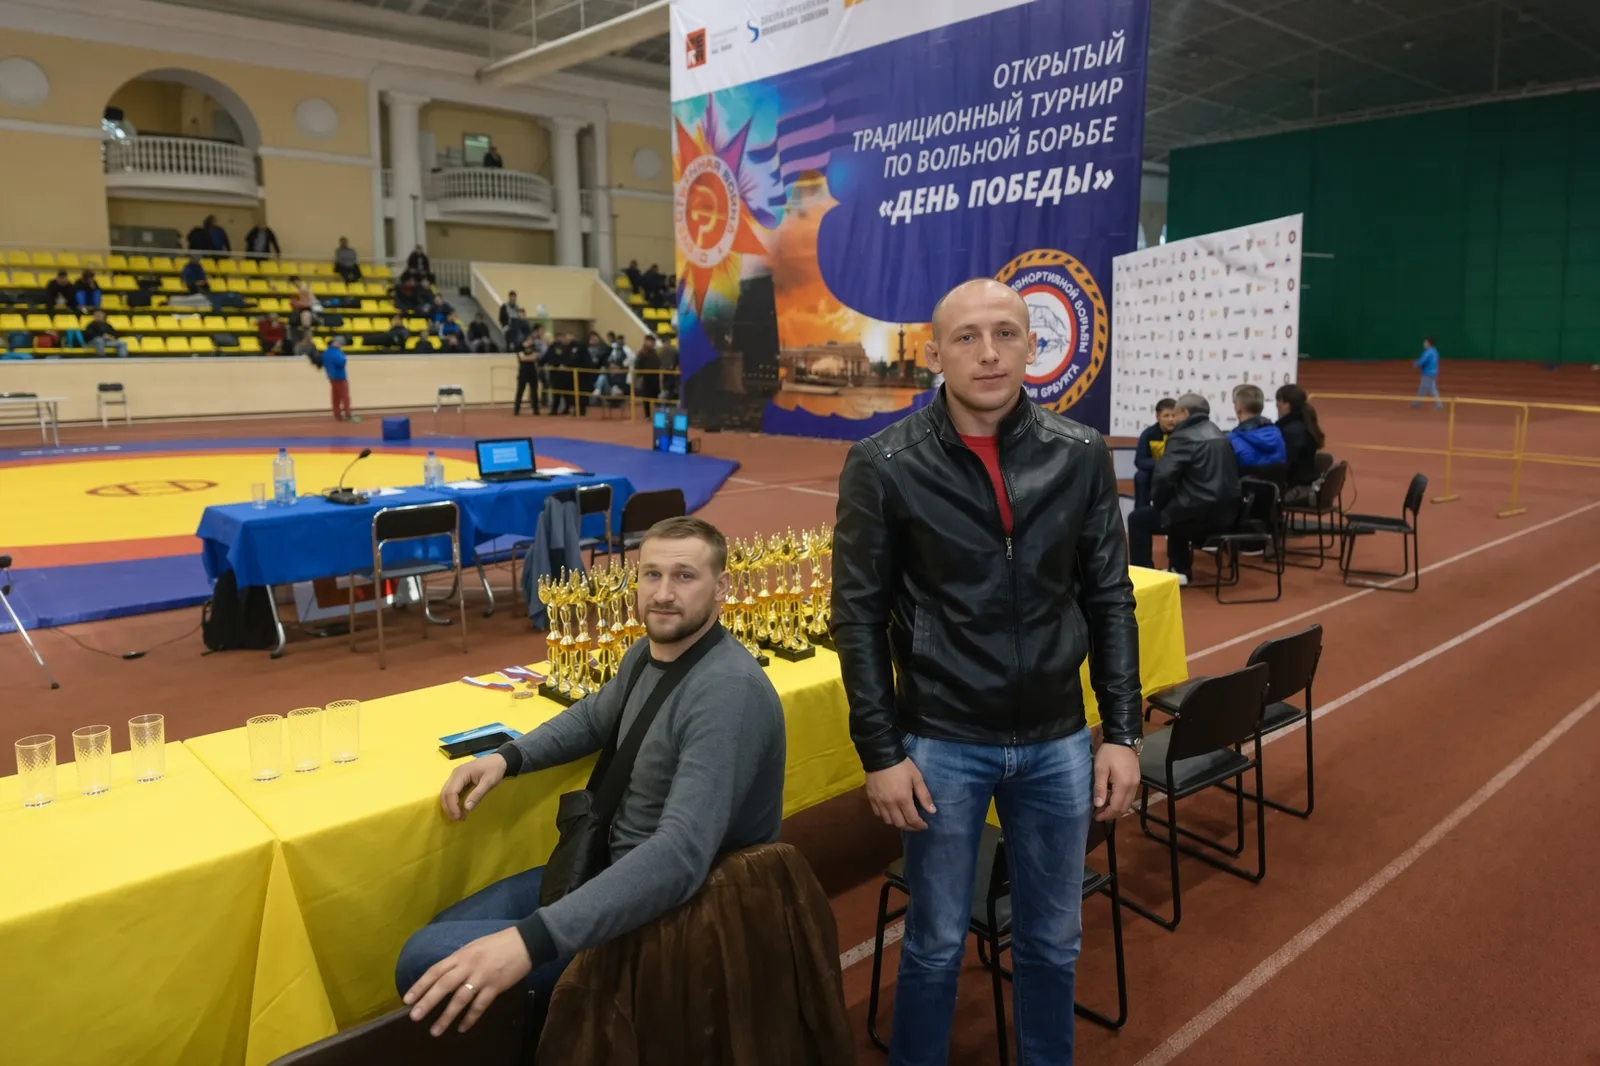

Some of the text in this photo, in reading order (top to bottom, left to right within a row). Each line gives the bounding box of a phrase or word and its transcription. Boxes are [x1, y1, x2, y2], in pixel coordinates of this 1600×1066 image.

[993, 29, 1126, 89] ОТКРЫТЫЙ
[853, 77, 1124, 152] ТРАДИЦИОННЫЙ ТУРНИР
[884, 116, 1118, 178] ПО ВОЛЬНОЙ БОРЬБЕ
[878, 162, 1115, 226] «ДЕНЬ ПОБЕДЫ»
